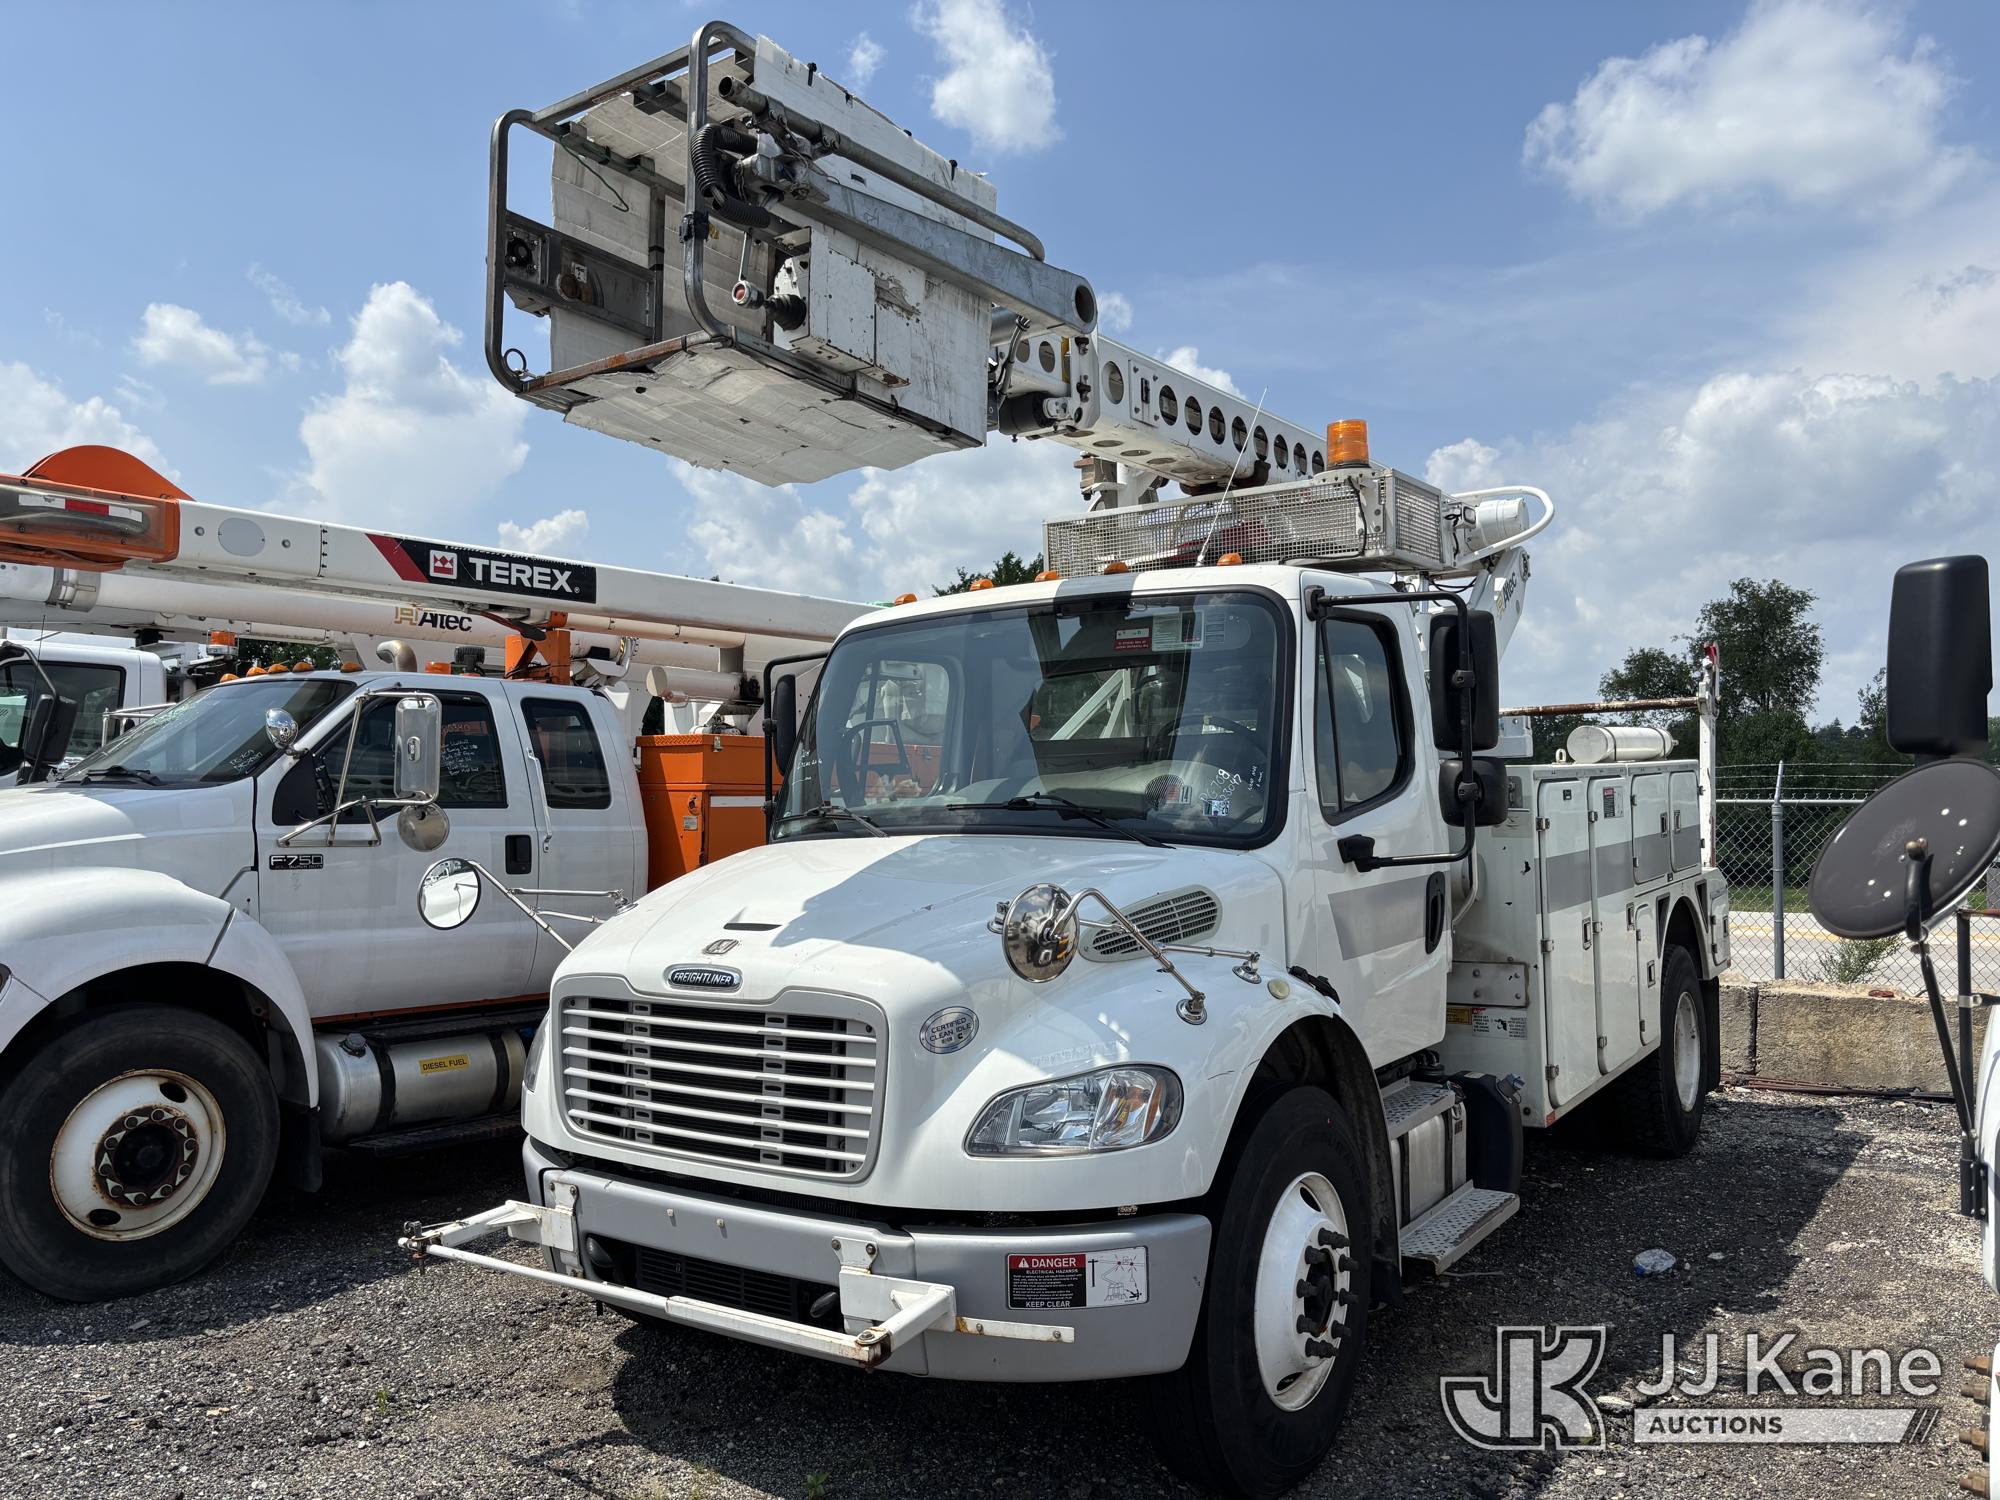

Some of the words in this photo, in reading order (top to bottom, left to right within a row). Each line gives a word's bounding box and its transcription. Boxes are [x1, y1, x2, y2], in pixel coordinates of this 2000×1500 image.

[469, 556, 573, 593] TEREX
[673, 972, 732, 985] FREIGHTLINER
[930, 1016, 967, 1034] CERTIFIED
[929, 1030, 954, 1042] CLEAN
[955, 1022, 972, 1033] IDLE
[422, 1061, 448, 1071] DIESEL
[448, 1058, 468, 1067] FUEL
[1031, 1257, 1077, 1268] DANGER
[1046, 1300, 1071, 1308] CLEAR
